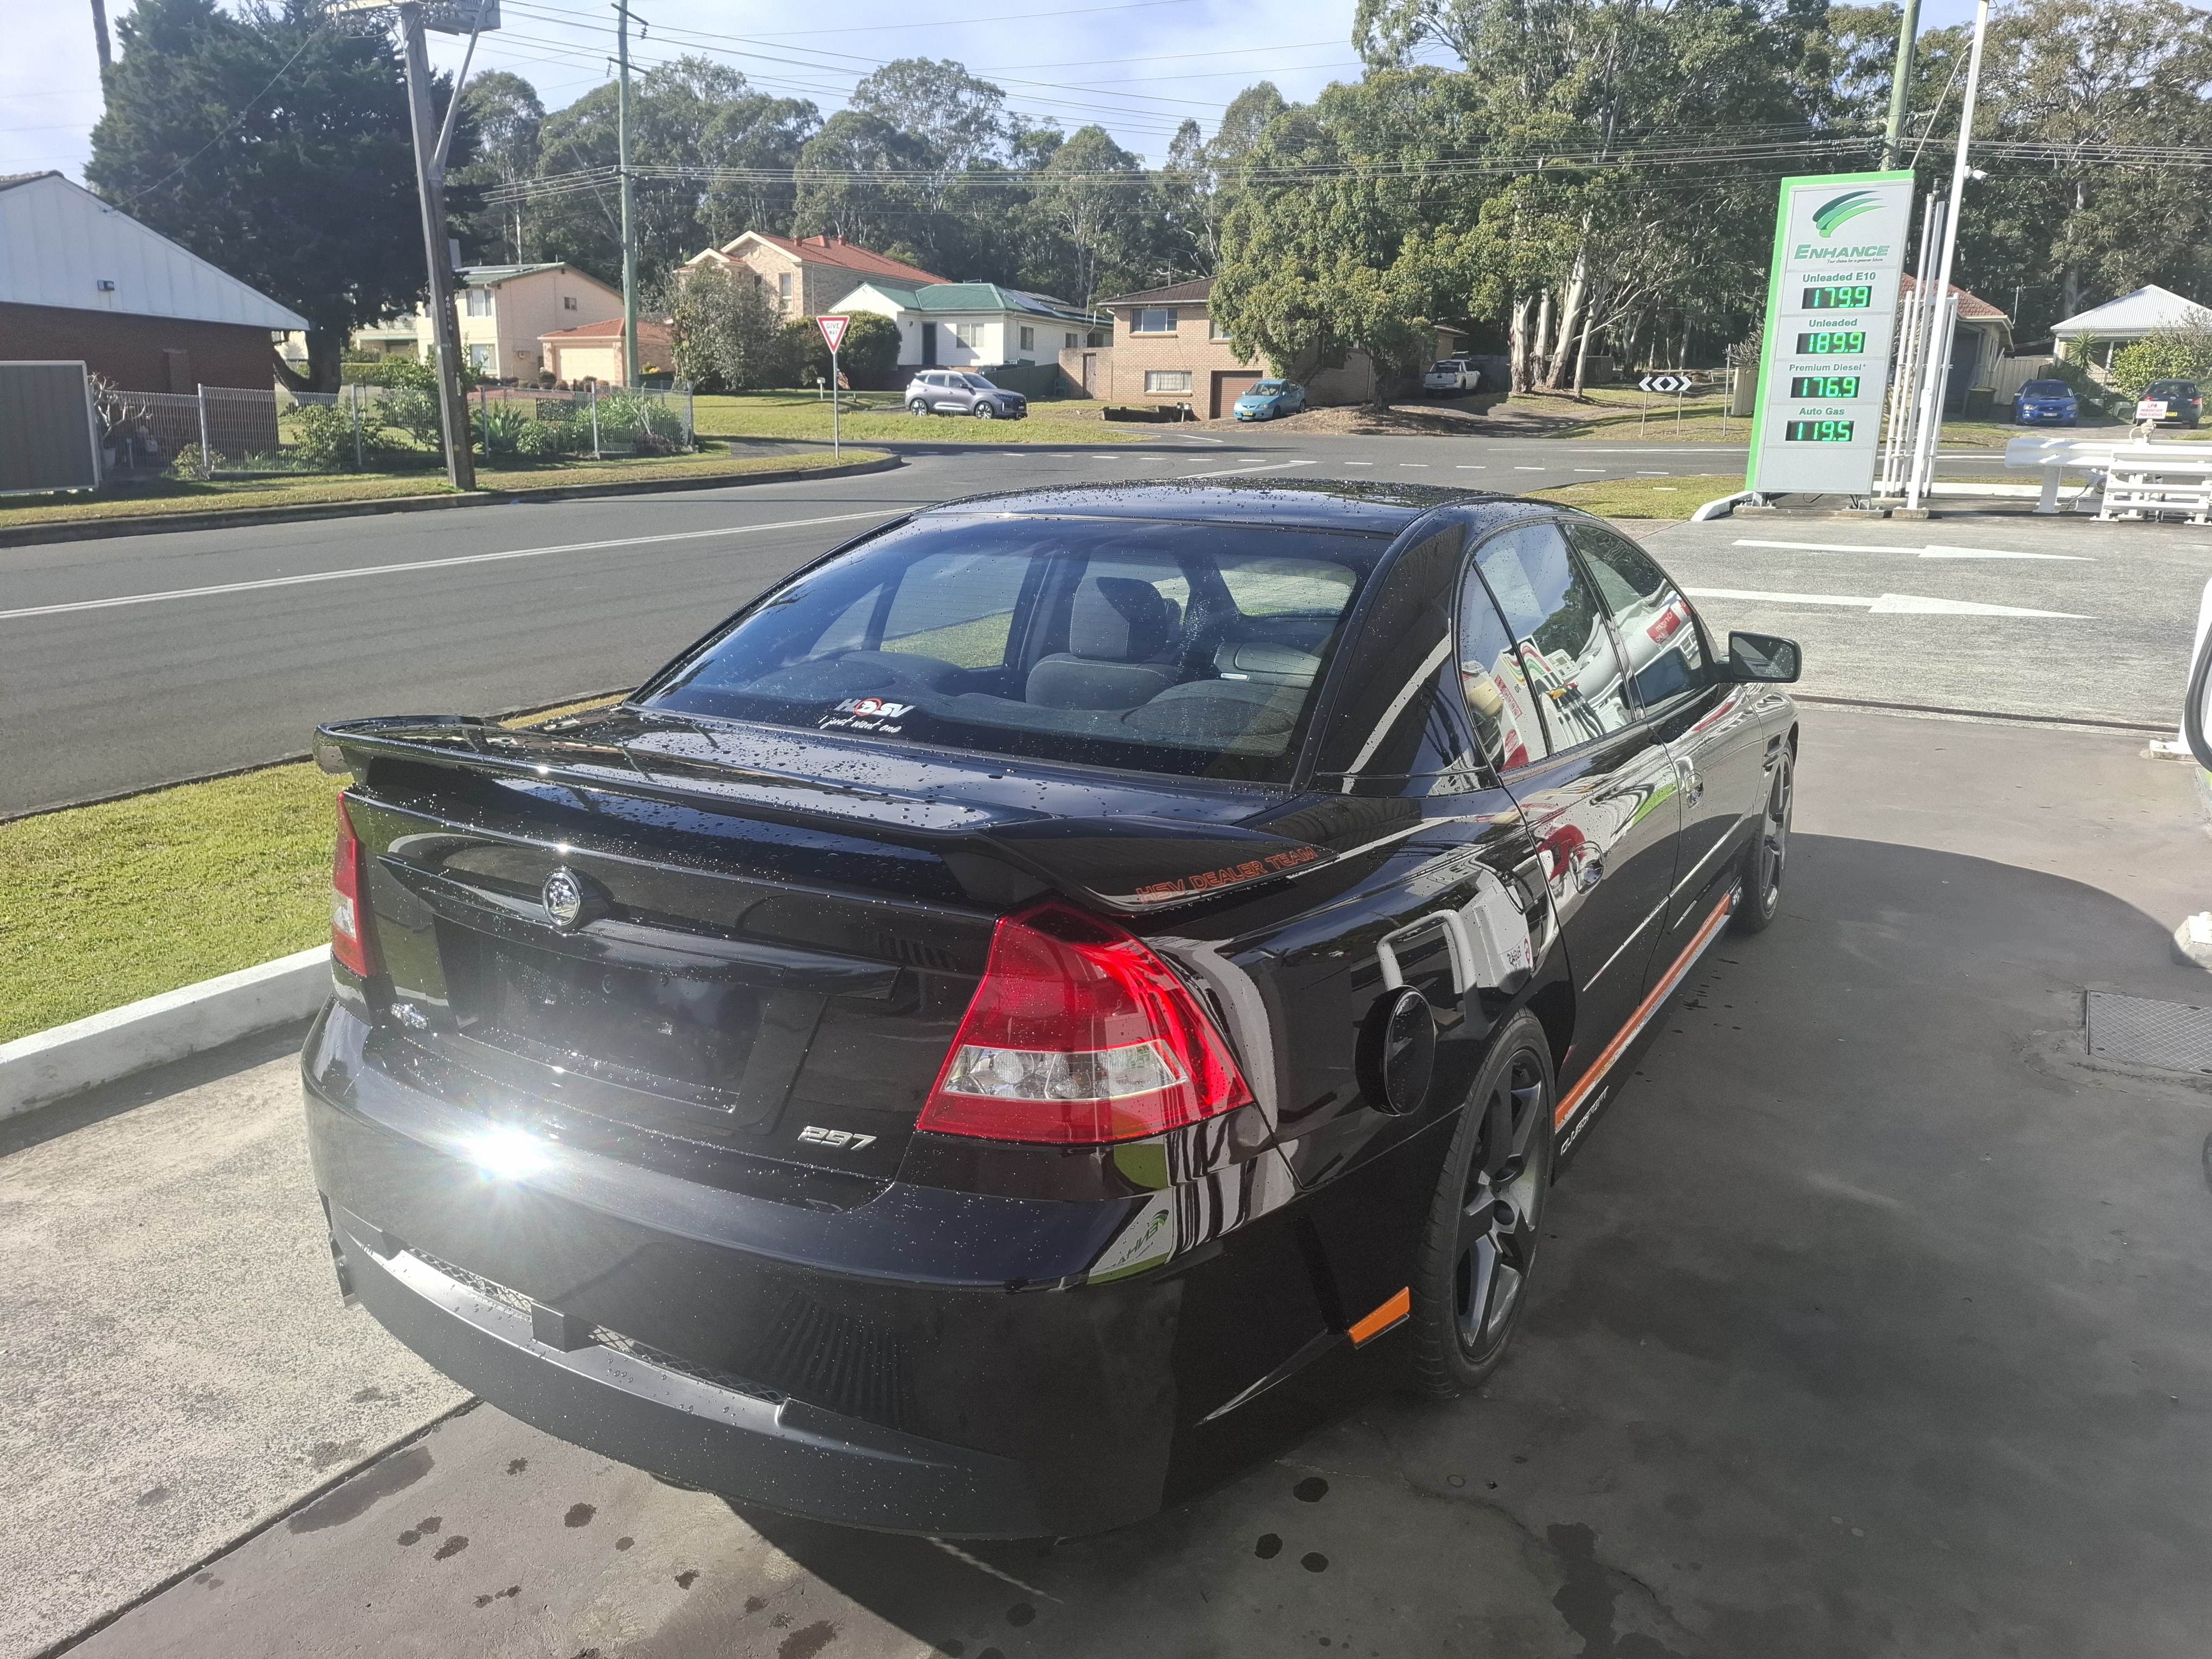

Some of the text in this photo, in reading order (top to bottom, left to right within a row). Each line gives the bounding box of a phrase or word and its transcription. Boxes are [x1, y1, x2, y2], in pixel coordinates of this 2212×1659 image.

[1794, 244, 1891, 259] ENHANCE
[1802, 272, 1876, 282] Unleaded E10
[1814, 286, 1868, 307] 179.9
[1809, 318, 1857, 327] Unleaded
[1809, 332, 1863, 353] 189.9
[1789, 364, 1830, 372] Premium
[1802, 377, 1856, 397] 176.9
[1799, 407, 1845, 415] Auto Gas
[1797, 421, 1850, 441] 119.5
[818, 715, 902, 732] I just want one
[1136, 846, 1319, 904] HSV DEALER TEAM
[798, 1126, 877, 1151] 297
